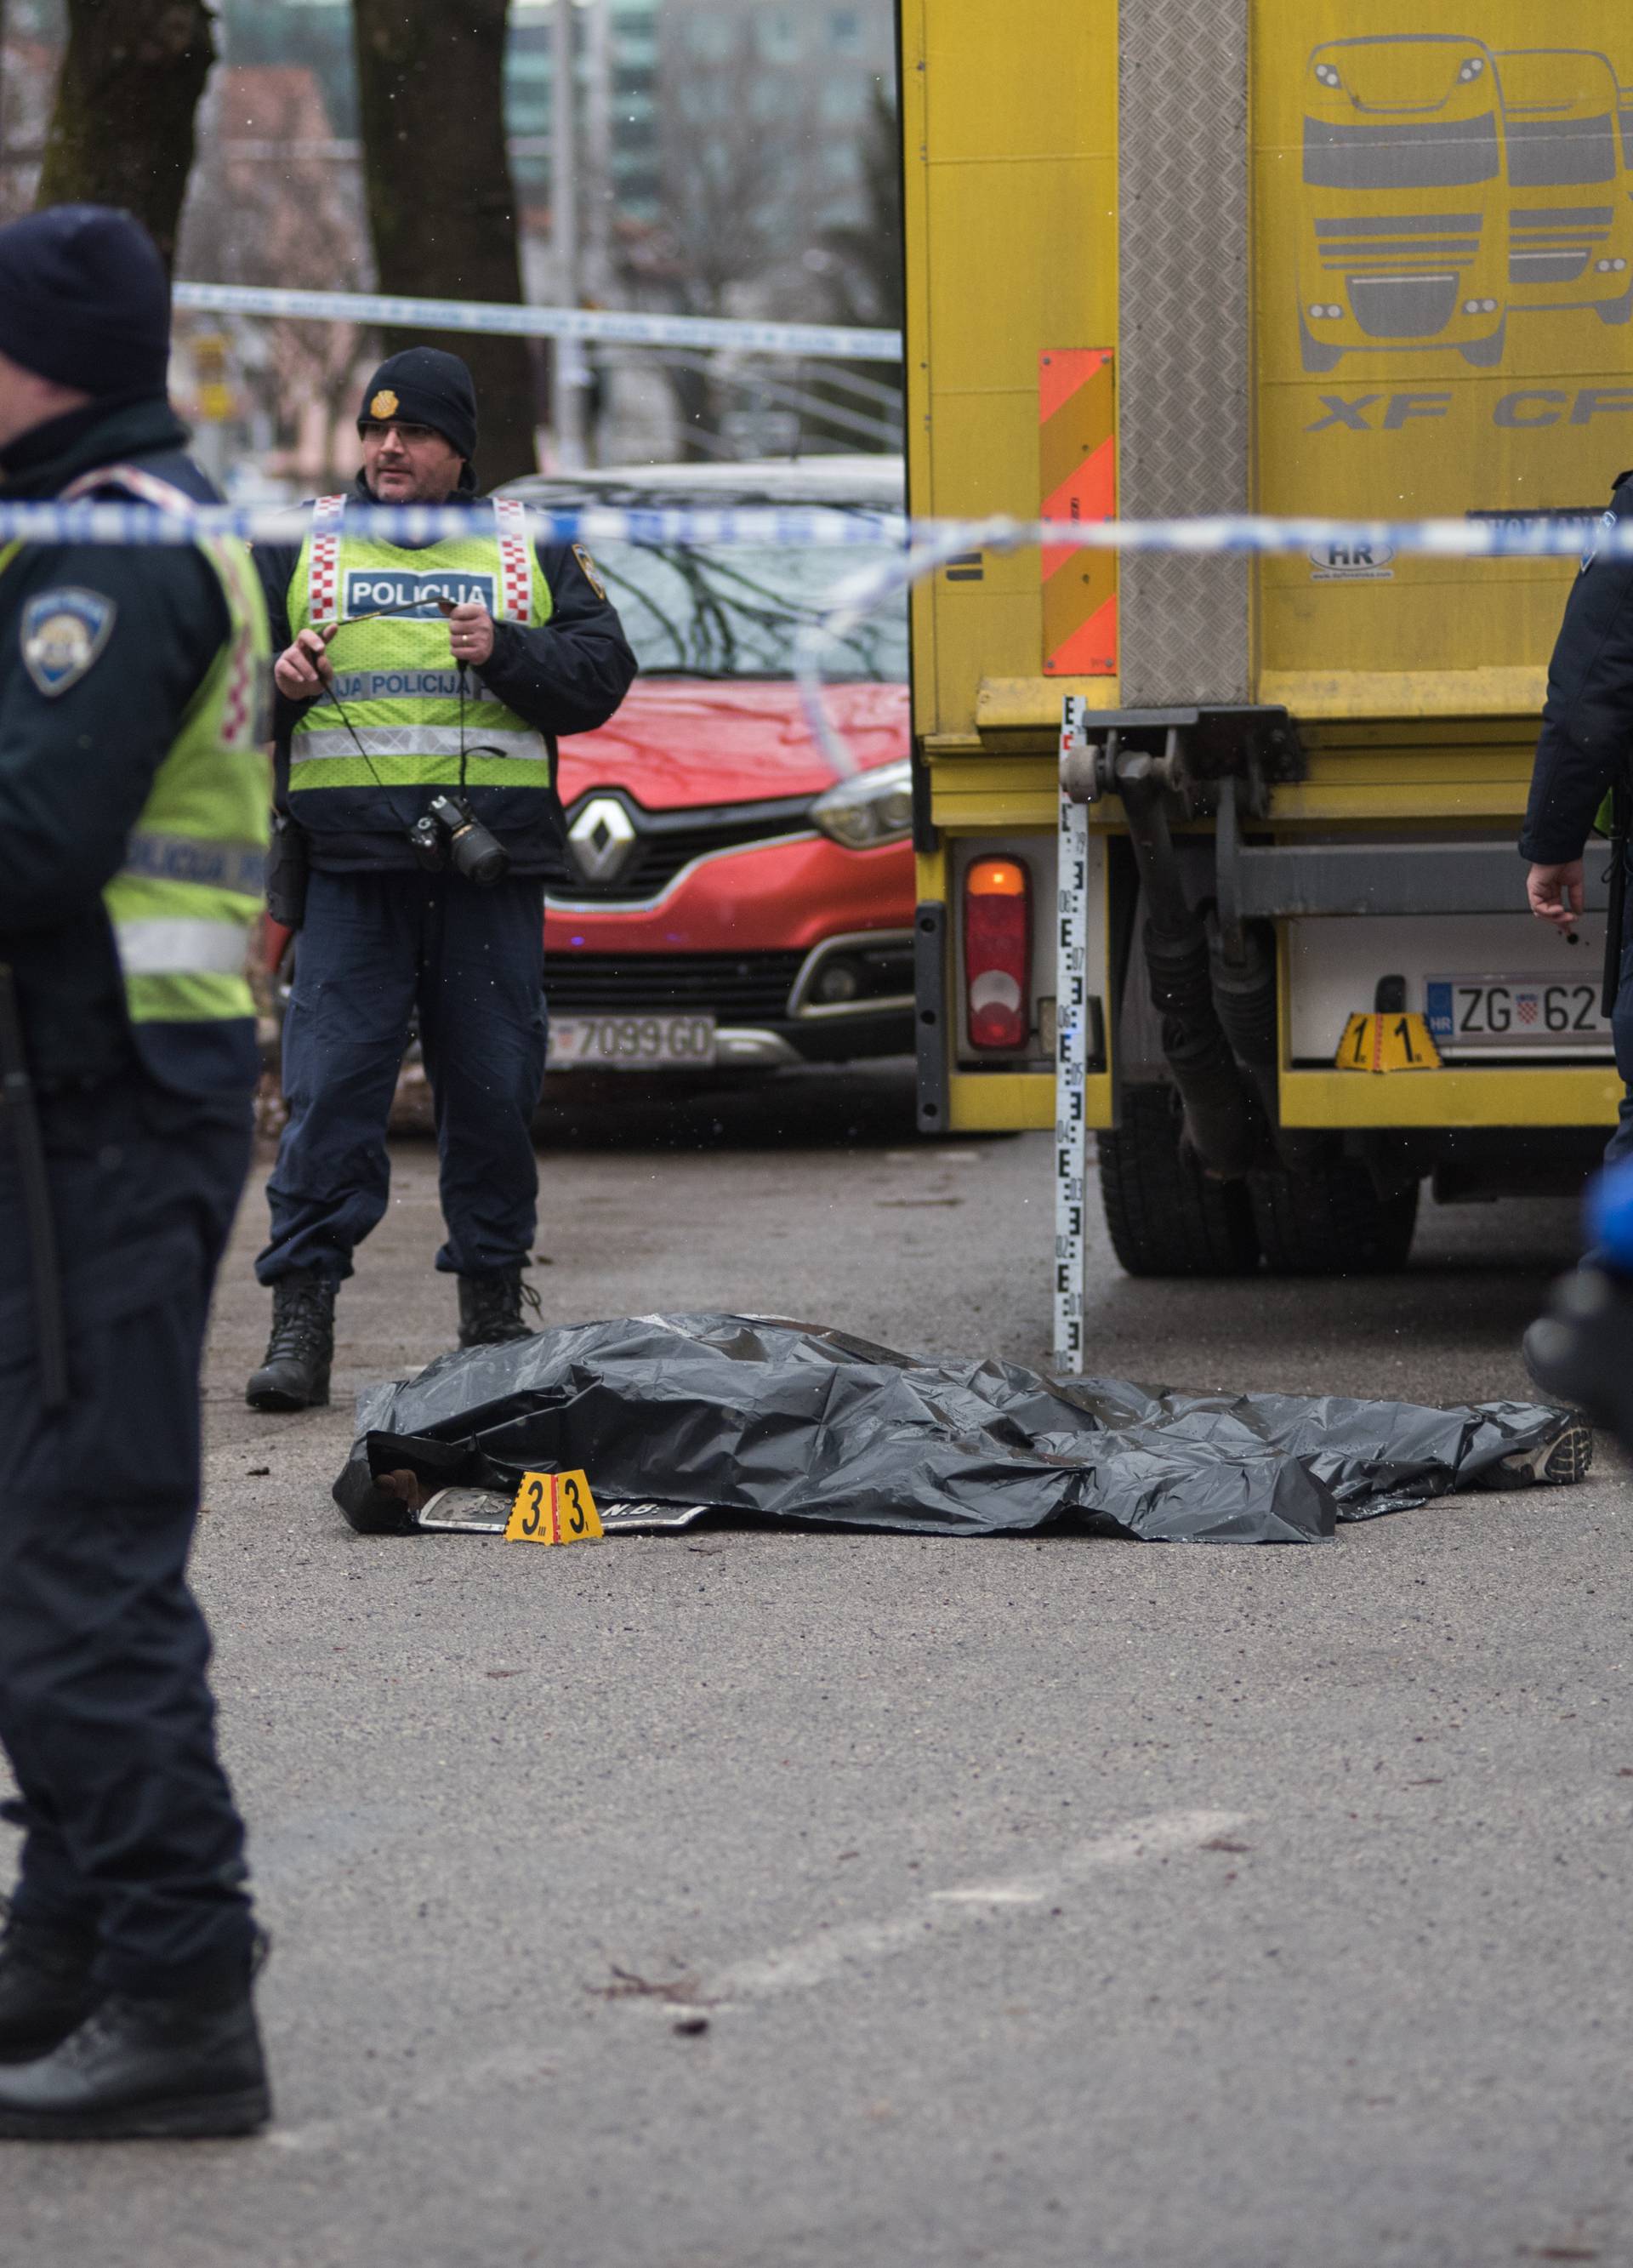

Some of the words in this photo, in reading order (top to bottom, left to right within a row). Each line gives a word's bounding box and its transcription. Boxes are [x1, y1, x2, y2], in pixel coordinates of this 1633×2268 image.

[1304, 392, 1453, 432] XF
[1493, 387, 1633, 429] CF
[1329, 540, 1374, 566] HR
[352, 582, 488, 607] POLICIJA
[372, 675, 471, 697] POLICIJA
[1430, 1017, 1452, 1031] HR
[1458, 988, 1511, 1032] ZG
[1544, 985, 1596, 1031] 62
[578, 1020, 662, 1057] 7099
[1353, 1017, 1368, 1063] 1
[1394, 1017, 1414, 1063] 1
[521, 1480, 543, 1536] 3
[564, 1479, 584, 1534] 3
